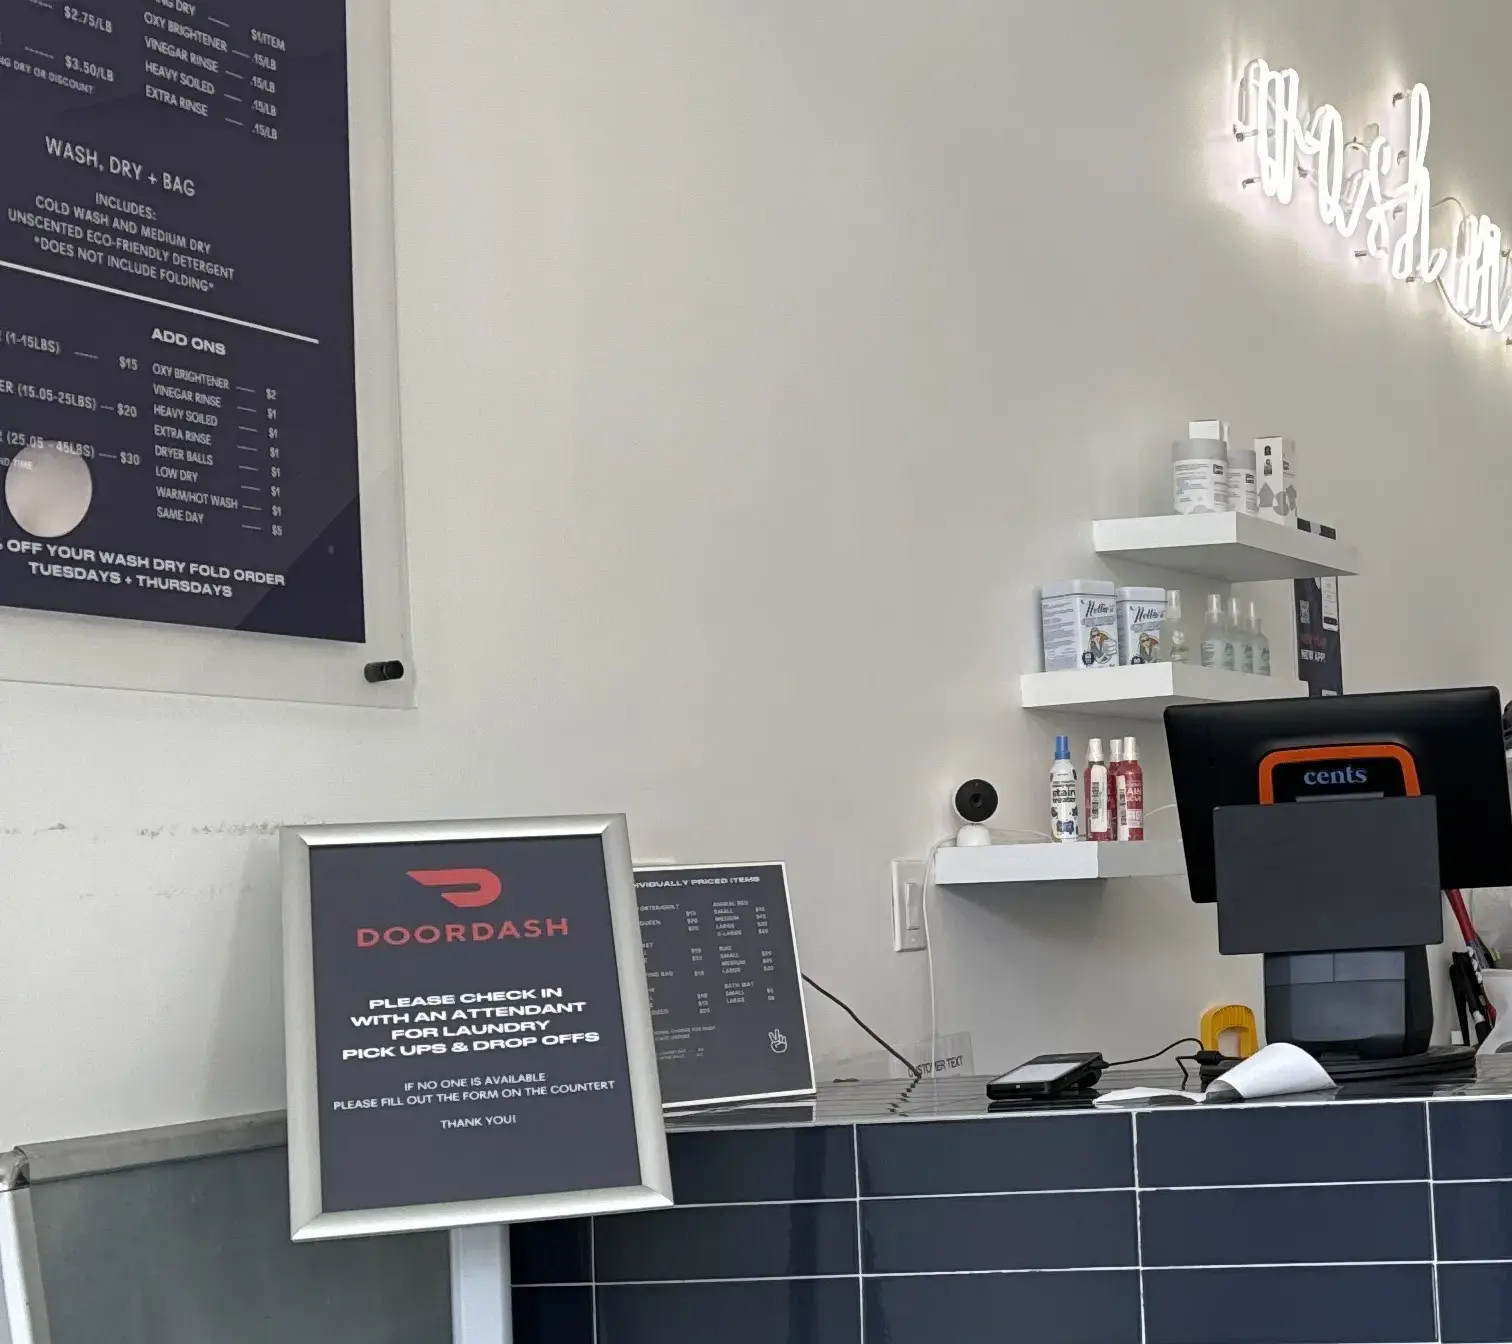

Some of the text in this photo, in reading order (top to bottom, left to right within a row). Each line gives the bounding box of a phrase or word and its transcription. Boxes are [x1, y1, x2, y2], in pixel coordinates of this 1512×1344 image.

[64, 5, 113, 33] $2.75/LB
[176, 0, 196, 16] DRY
[144, 11, 228, 53] OXY BRIGHTENER
[13, 60, 31, 74] DRY
[33, 67, 47, 80] OR
[65, 54, 114, 82] $3.50/LB
[144, 36, 219, 73] VINEGAR RINSE
[145, 60, 215, 95] HEAVY SOILED
[145, 84, 208, 117] EXTRA RINSE
[109, 155, 143, 181] DRY
[147, 173, 158, 185] +
[162, 172, 196, 197] BAG
[95, 192, 158, 220] INCLUDES:
[35, 195, 212, 255] COLD WASH AND MEDIUM DRY
[7, 208, 235, 280] UNSCENTED ECO-FRIENDLY DETERGENT
[77, 247, 104, 264] NOT
[107, 255, 157, 279] INCLUDE
[5, 330, 138, 371] (1-15LBS) $15
[151, 327, 227, 356] ADD ONS
[152, 363, 277, 400] OXY BRIGHTENER $2
[17, 383, 138, 418] (15.05-25LBS) $20
[153, 384, 277, 420] VINEGAR RINSE $1
[153, 404, 278, 439] HEAVY SOILED $1
[55, 440, 96, 459] 45LBS)
[119, 451, 141, 466] $30
[153, 424, 280, 459] EXTRA RINSE $1
[154, 445, 281, 478] DRYER BALLS $1
[155, 466, 281, 498] LOW DRY $1
[156, 485, 282, 517] WARM/HOT WASH $1
[156, 506, 283, 537] SAME DAY $5
[6, 539, 43, 555] OFF
[45, 544, 96, 563] YOUR
[98, 551, 150, 570] WASH
[152, 558, 186, 574] DRY
[189, 562, 230, 580] FOLD
[233, 569, 286, 586] ORDER
[28, 561, 233, 598] TUESDAYS THURSDAYS
[1303, 763, 1367, 785] cents
[691, 877, 728, 886] PRICED
[730, 875, 761, 884] ITEMS
[356, 917, 569, 948] DOORDASH
[350, 1001, 587, 1028] WITH AN ATTENDANT
[368, 987, 563, 1010] PLEASE CHECK IN
[341, 1031, 600, 1061] PICK UPS & DROP OFFS
[391, 1019, 551, 1041] FOR LAUNDRY
[333, 1079, 615, 1111] PLEASE FILL OUT THE FORM ON THE COUNTERT
[404, 1072, 546, 1092] IF NO ONE IS AVAILABLE
[440, 1114, 517, 1130] THANK YOU!
